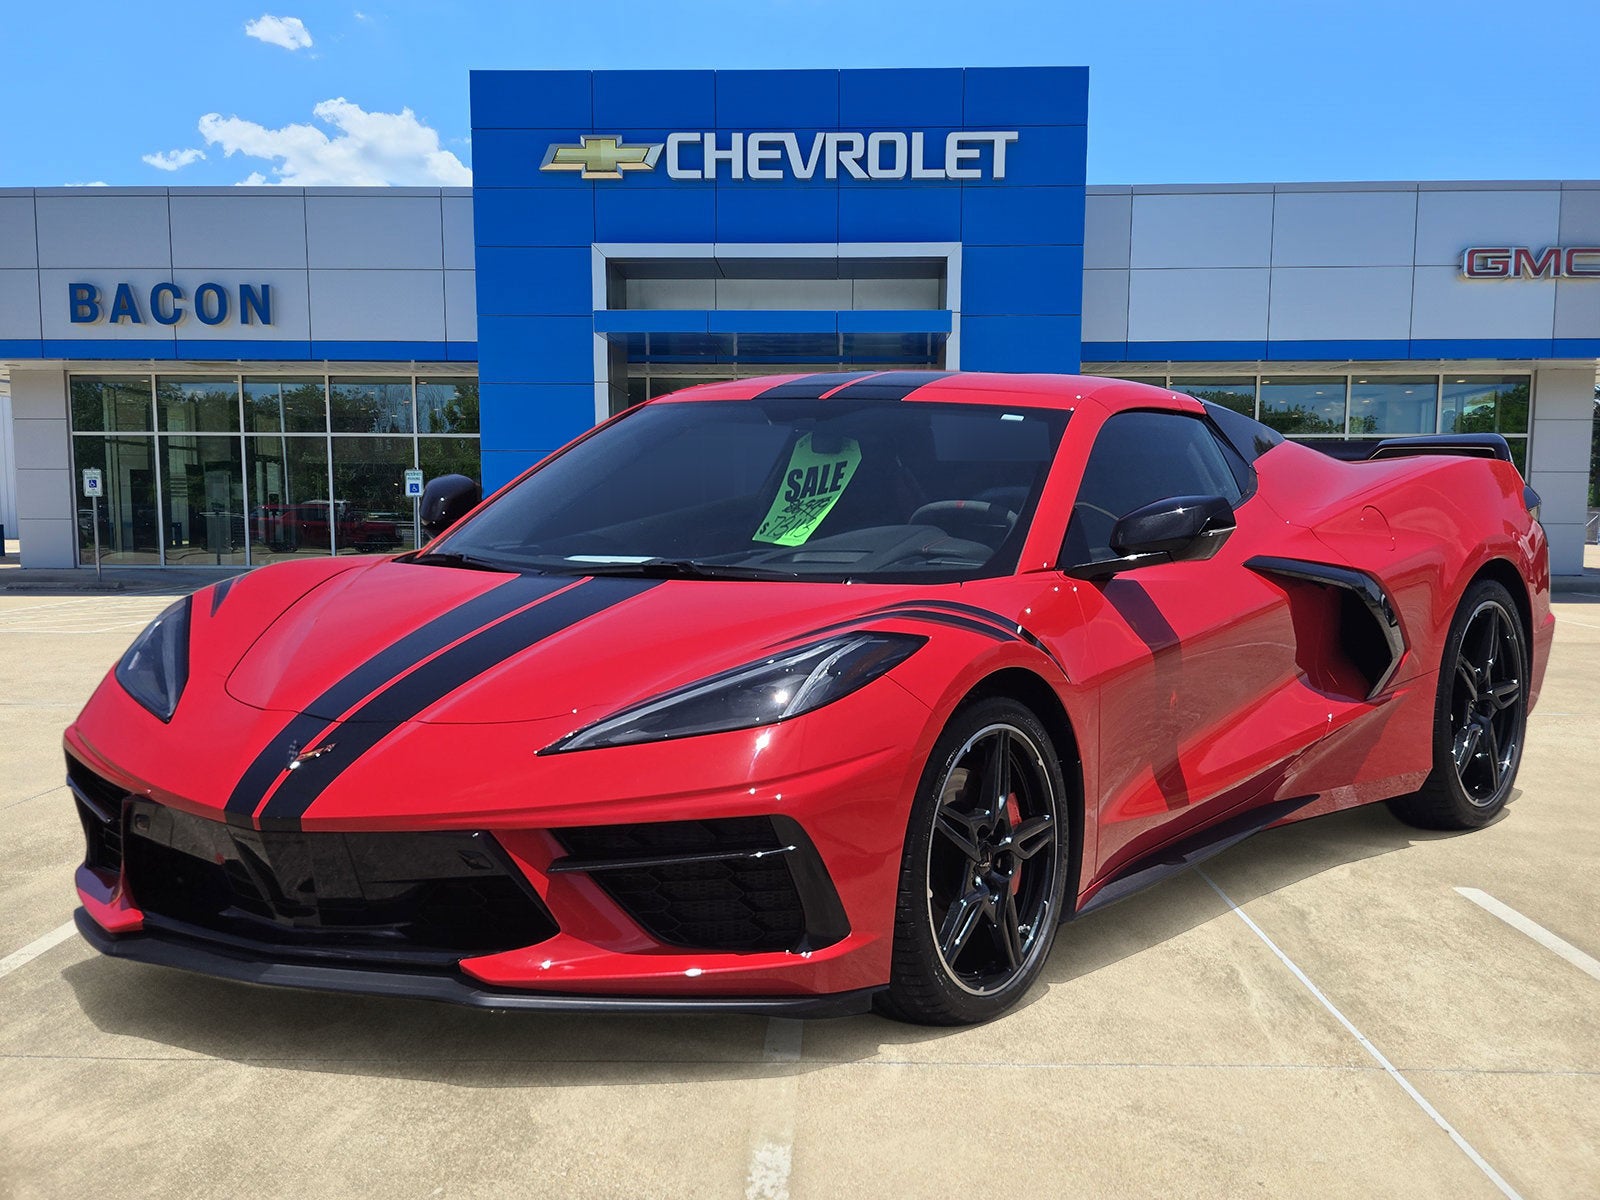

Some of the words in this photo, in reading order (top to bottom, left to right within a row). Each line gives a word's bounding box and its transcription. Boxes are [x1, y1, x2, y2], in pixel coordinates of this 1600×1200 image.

[666, 131, 1019, 180] CHEVROLET
[1463, 246, 1600, 278] GMC
[69, 282, 272, 326] BACON
[785, 460, 848, 503] SALE
